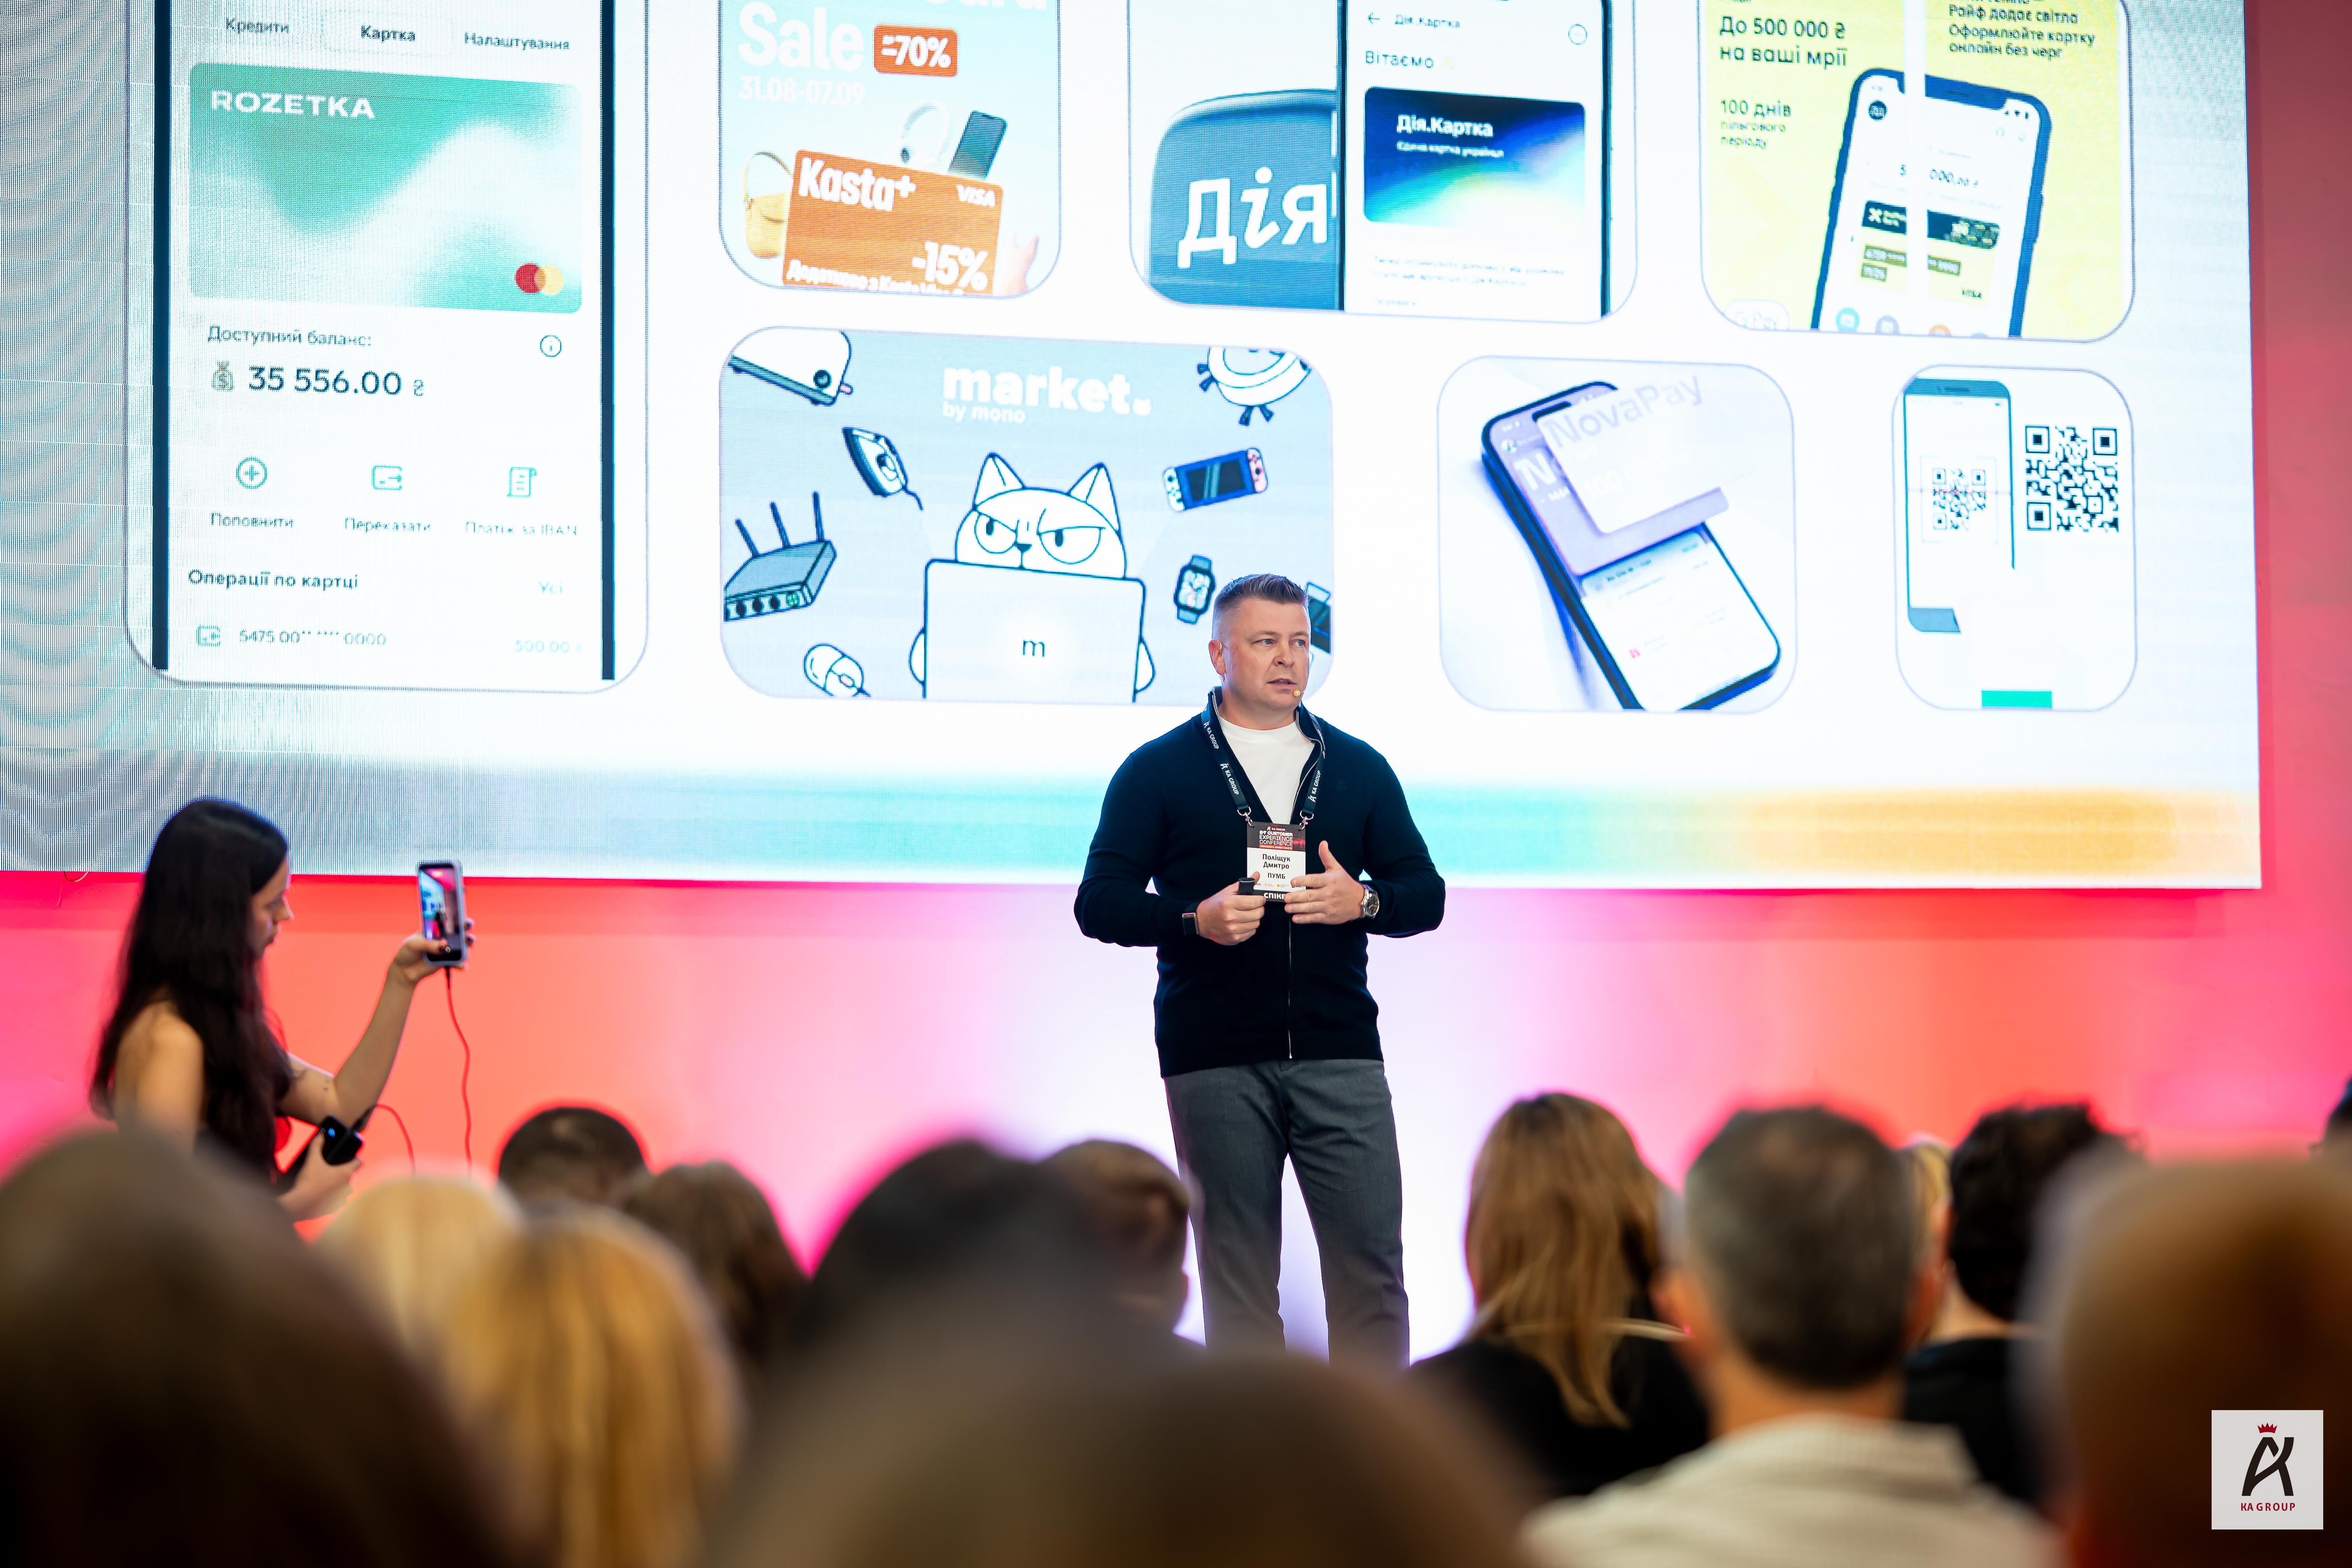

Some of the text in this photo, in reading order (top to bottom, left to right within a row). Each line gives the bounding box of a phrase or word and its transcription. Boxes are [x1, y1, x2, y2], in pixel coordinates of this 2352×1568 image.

[1949, 4, 2078, 24] Райф додає світла
[226, 17, 290, 34] Кредити
[361, 24, 416, 43] Картка
[738, 1, 864, 72] Sale
[1719, 16, 1746, 36] До
[1754, 17, 1787, 36] 500
[1794, 19, 1828, 38] 000
[1949, 23, 2096, 47] Оформлюйте картку
[464, 31, 570, 51] Налаштування
[1949, 40, 2063, 61] онлайн без черг
[1365, 50, 1434, 68] Вітаємо
[1720, 45, 1848, 70] на ваші мрії
[739, 76, 865, 106] 31.08-07.09
[211, 90, 375, 119] ROZETKA
[1721, 99, 1792, 118] 100 днів
[1396, 114, 1493, 137] Дія.Картка
[957, 185, 995, 207] VISA
[1177, 167, 1327, 268] Дія
[912, 241, 988, 291] -15%
[208, 325, 372, 347] Доступний баланс:
[248, 365, 284, 392] 35
[294, 367, 402, 395] 556.00
[943, 401, 1026, 424] by mono
[1543, 375, 1703, 448] NovaPay
[210, 511, 294, 528] Поповнити
[541, 524, 578, 536] IBAN
[189, 569, 358, 591] Операції по картці
[344, 632, 386, 646] 0000
[1022, 640, 1045, 657] m
[1207, 726, 1220, 750] KA GROUP
[1225, 770, 1239, 796] KA GROUP
[1311, 770, 1322, 794] KA GROUP
[1262, 854, 1291, 862] Поліщук
[1263, 861, 1290, 870] Дмитро
